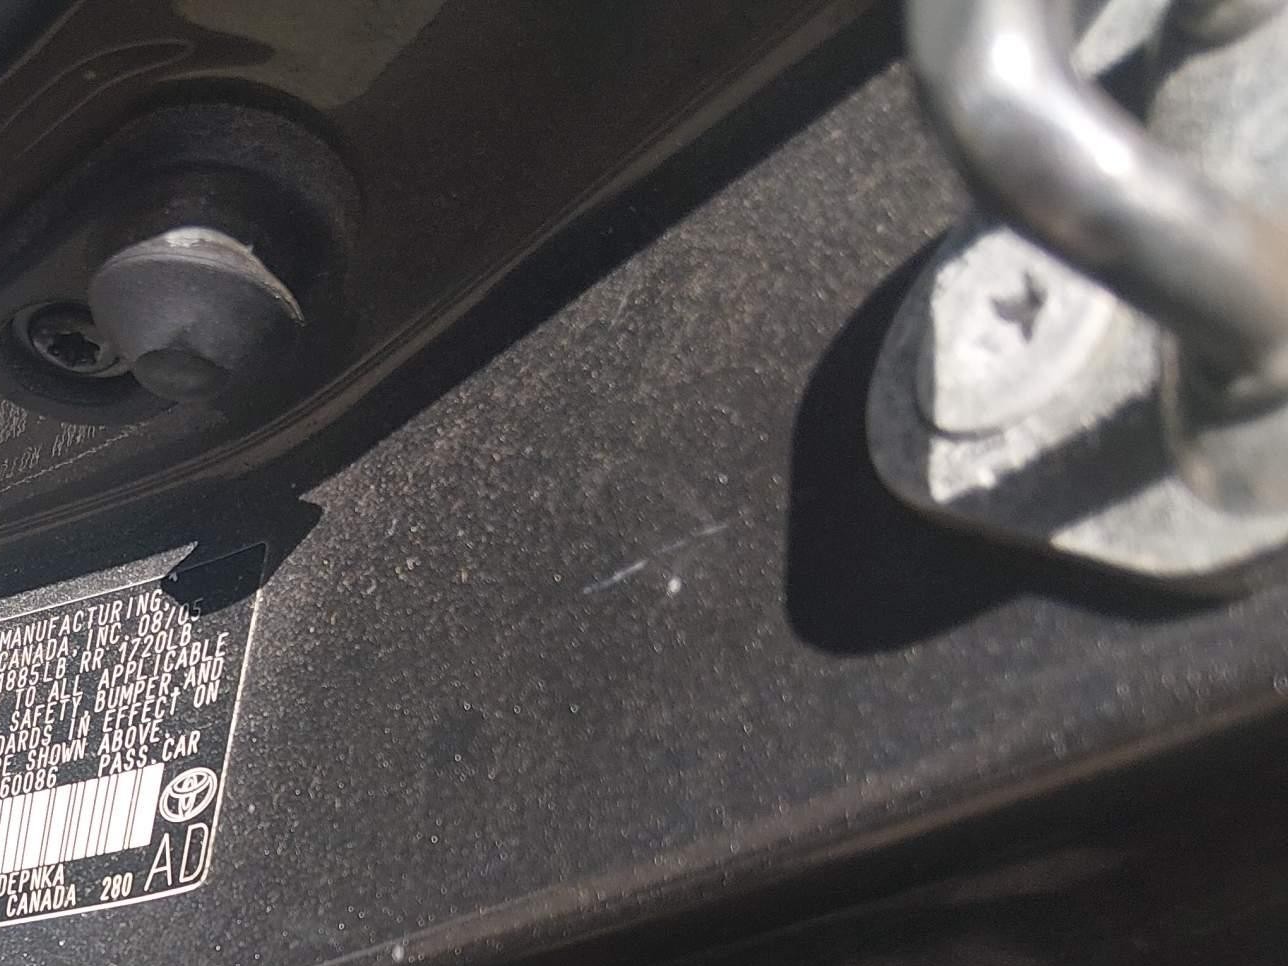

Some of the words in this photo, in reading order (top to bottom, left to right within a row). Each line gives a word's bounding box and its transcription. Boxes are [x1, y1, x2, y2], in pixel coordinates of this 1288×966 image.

[13, 683, 37, 710] TO
[47, 672, 86, 703] ALL
[97, 631, 229, 691] APPLICABLE
[78, 645, 105, 674] RR
[67, 715, 91, 741] IN
[101, 688, 180, 734] EFFECT
[191, 679, 220, 709] ON
[24, 736, 87, 772] SHOWN
[96, 715, 173, 756] ABOVE.
[142, 820, 212, 892] AD
[4, 881, 78, 918] CANADA
[98, 871, 134, 902] 280
